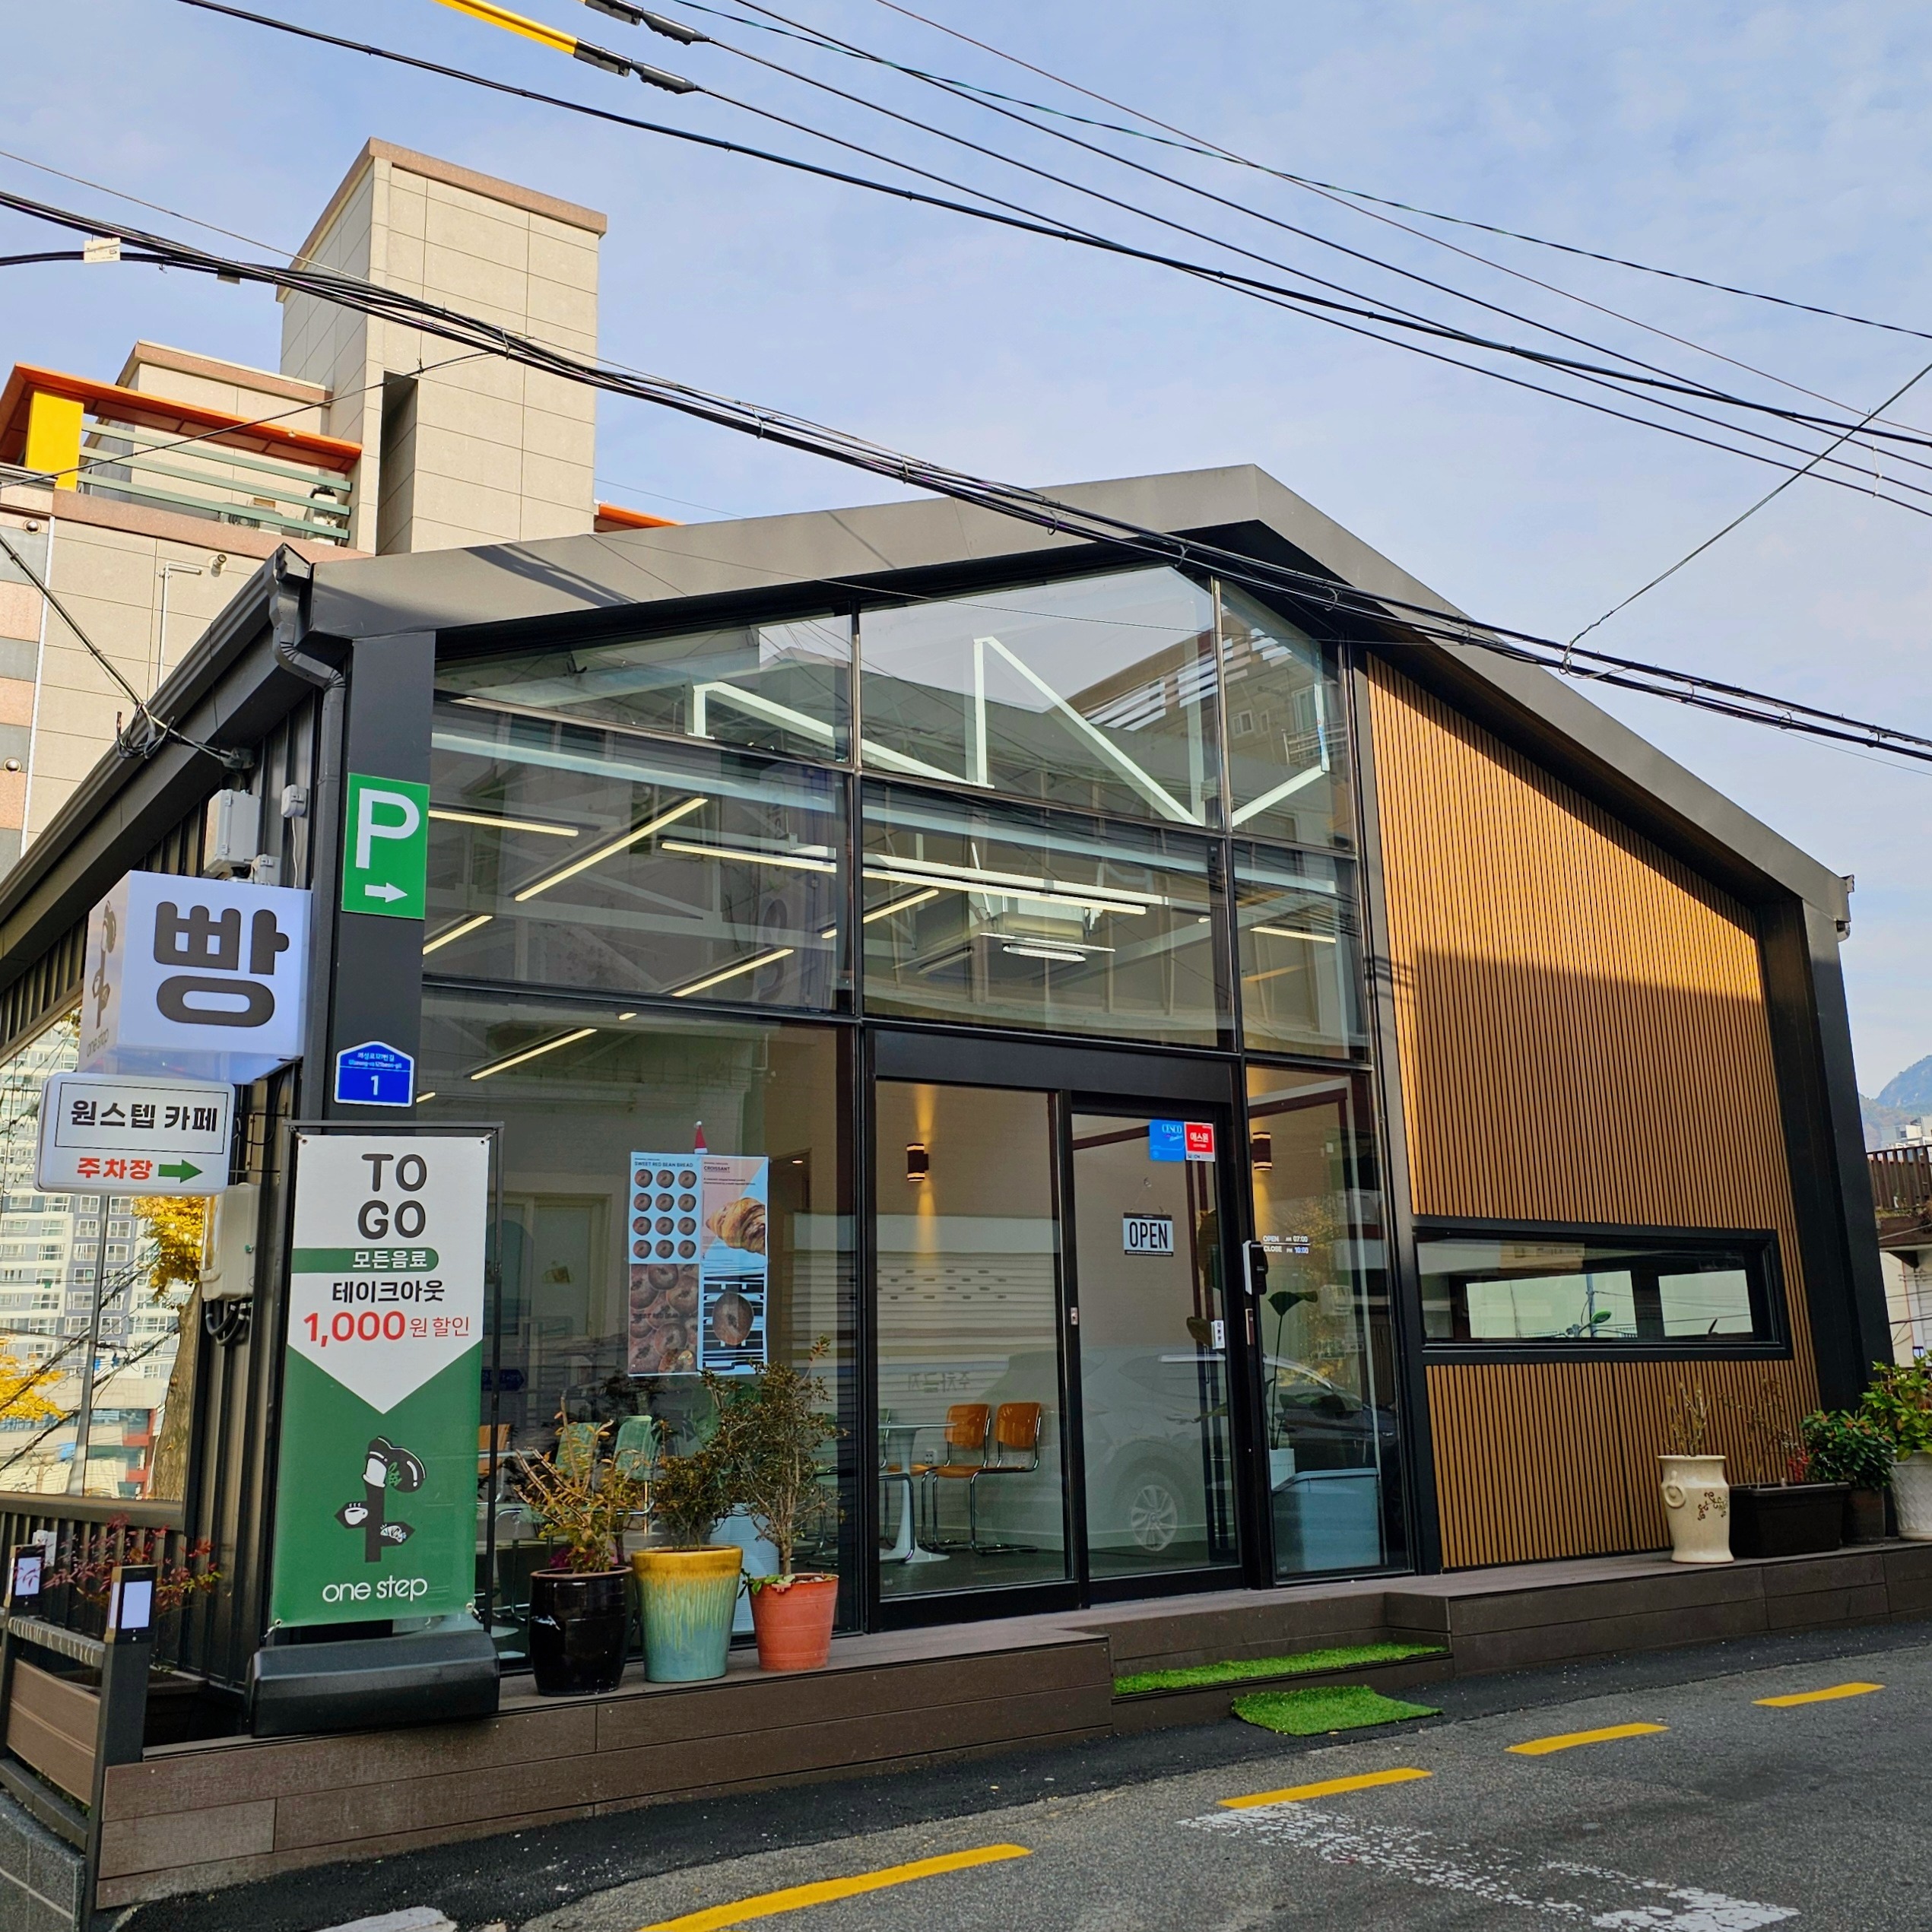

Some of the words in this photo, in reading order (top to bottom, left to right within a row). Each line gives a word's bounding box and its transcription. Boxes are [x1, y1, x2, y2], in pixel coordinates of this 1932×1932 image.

[356, 788, 420, 868] P
[153, 901, 290, 1028] 빵
[370, 1075, 379, 1096] 1
[71, 1100, 156, 1129] 원스텝
[164, 1106, 217, 1132] 카페
[77, 1157, 153, 1180] 주차장
[361, 1153, 427, 1192] TO
[357, 1200, 426, 1240] GO
[1129, 1221, 1168, 1248] OPEN
[352, 1250, 427, 1269] 모든음료
[332, 1280, 446, 1303] 테이크아웃
[432, 1316, 470, 1337] 할인
[322, 1581, 371, 1603] one
[376, 1575, 428, 1601] step
